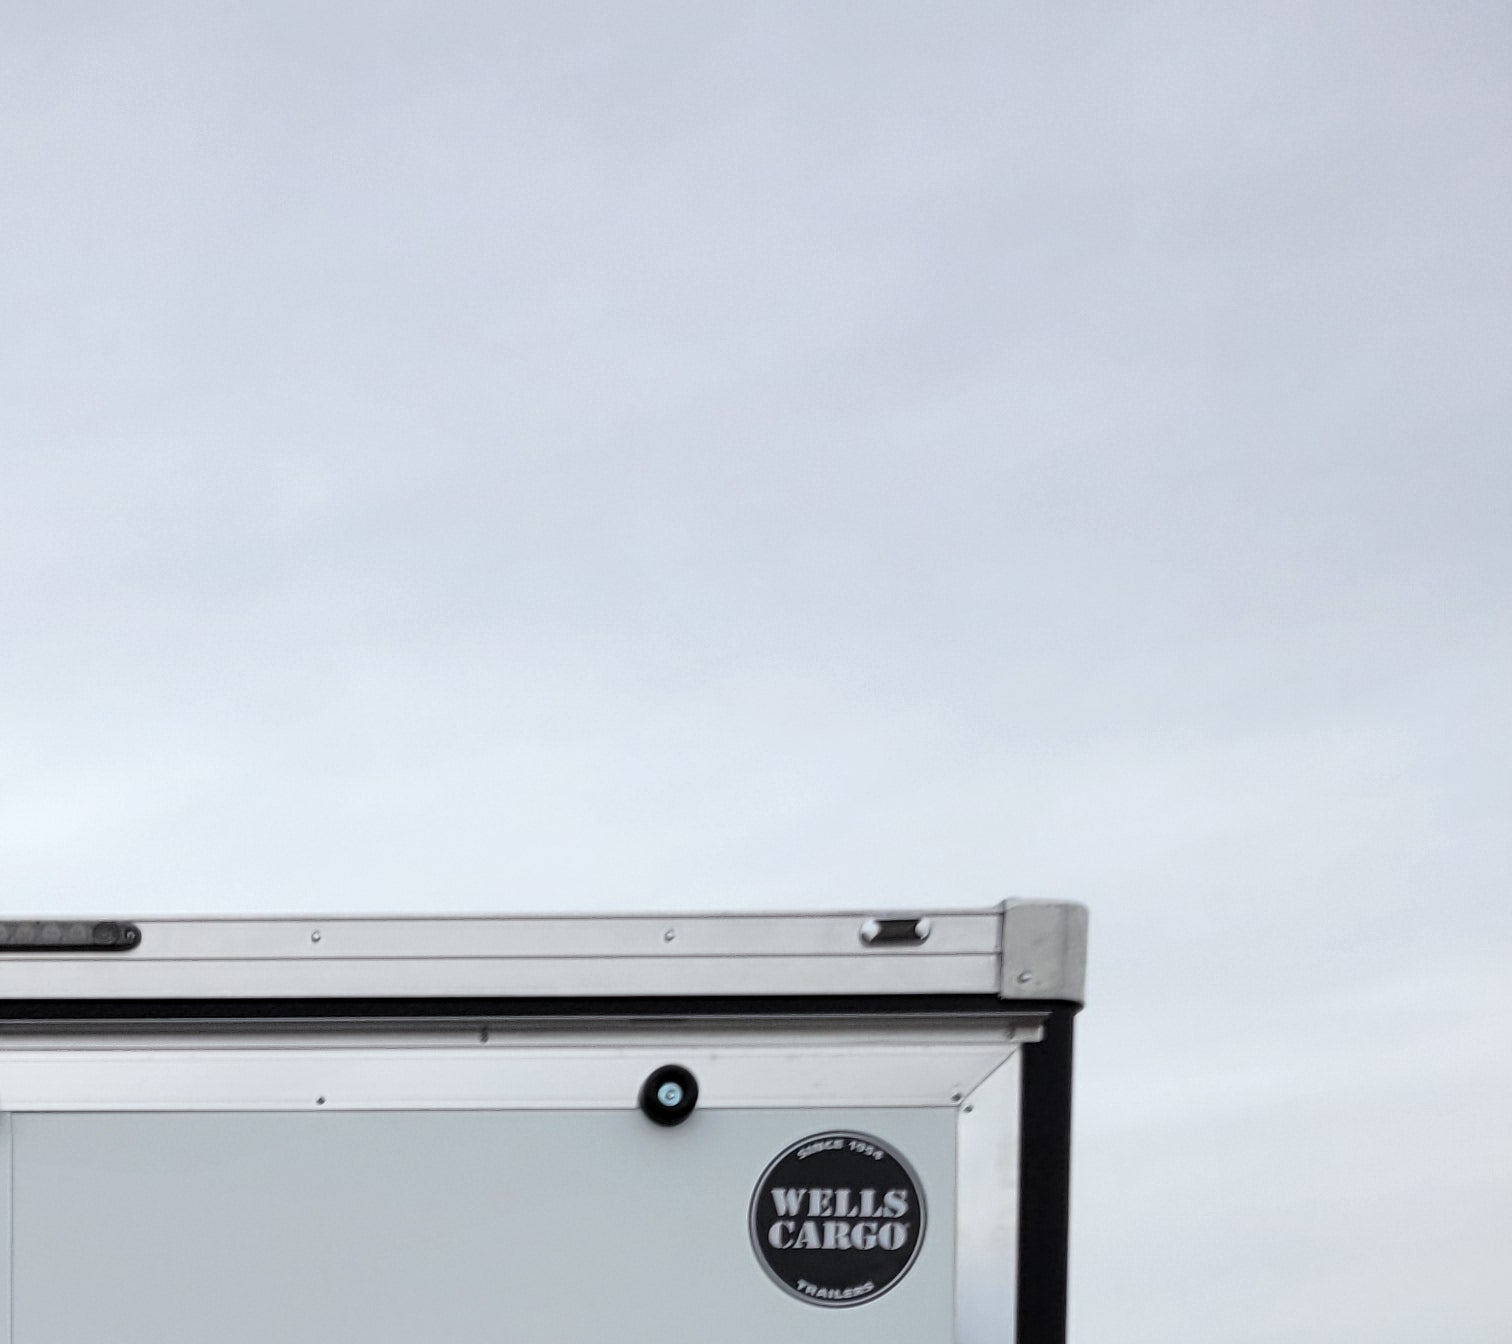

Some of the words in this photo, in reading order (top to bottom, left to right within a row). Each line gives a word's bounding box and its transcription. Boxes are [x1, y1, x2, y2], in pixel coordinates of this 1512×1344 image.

[770, 1187, 910, 1219] WELLS
[767, 1219, 908, 1251] CARGO
[796, 1278, 875, 1300] TRAILERS
